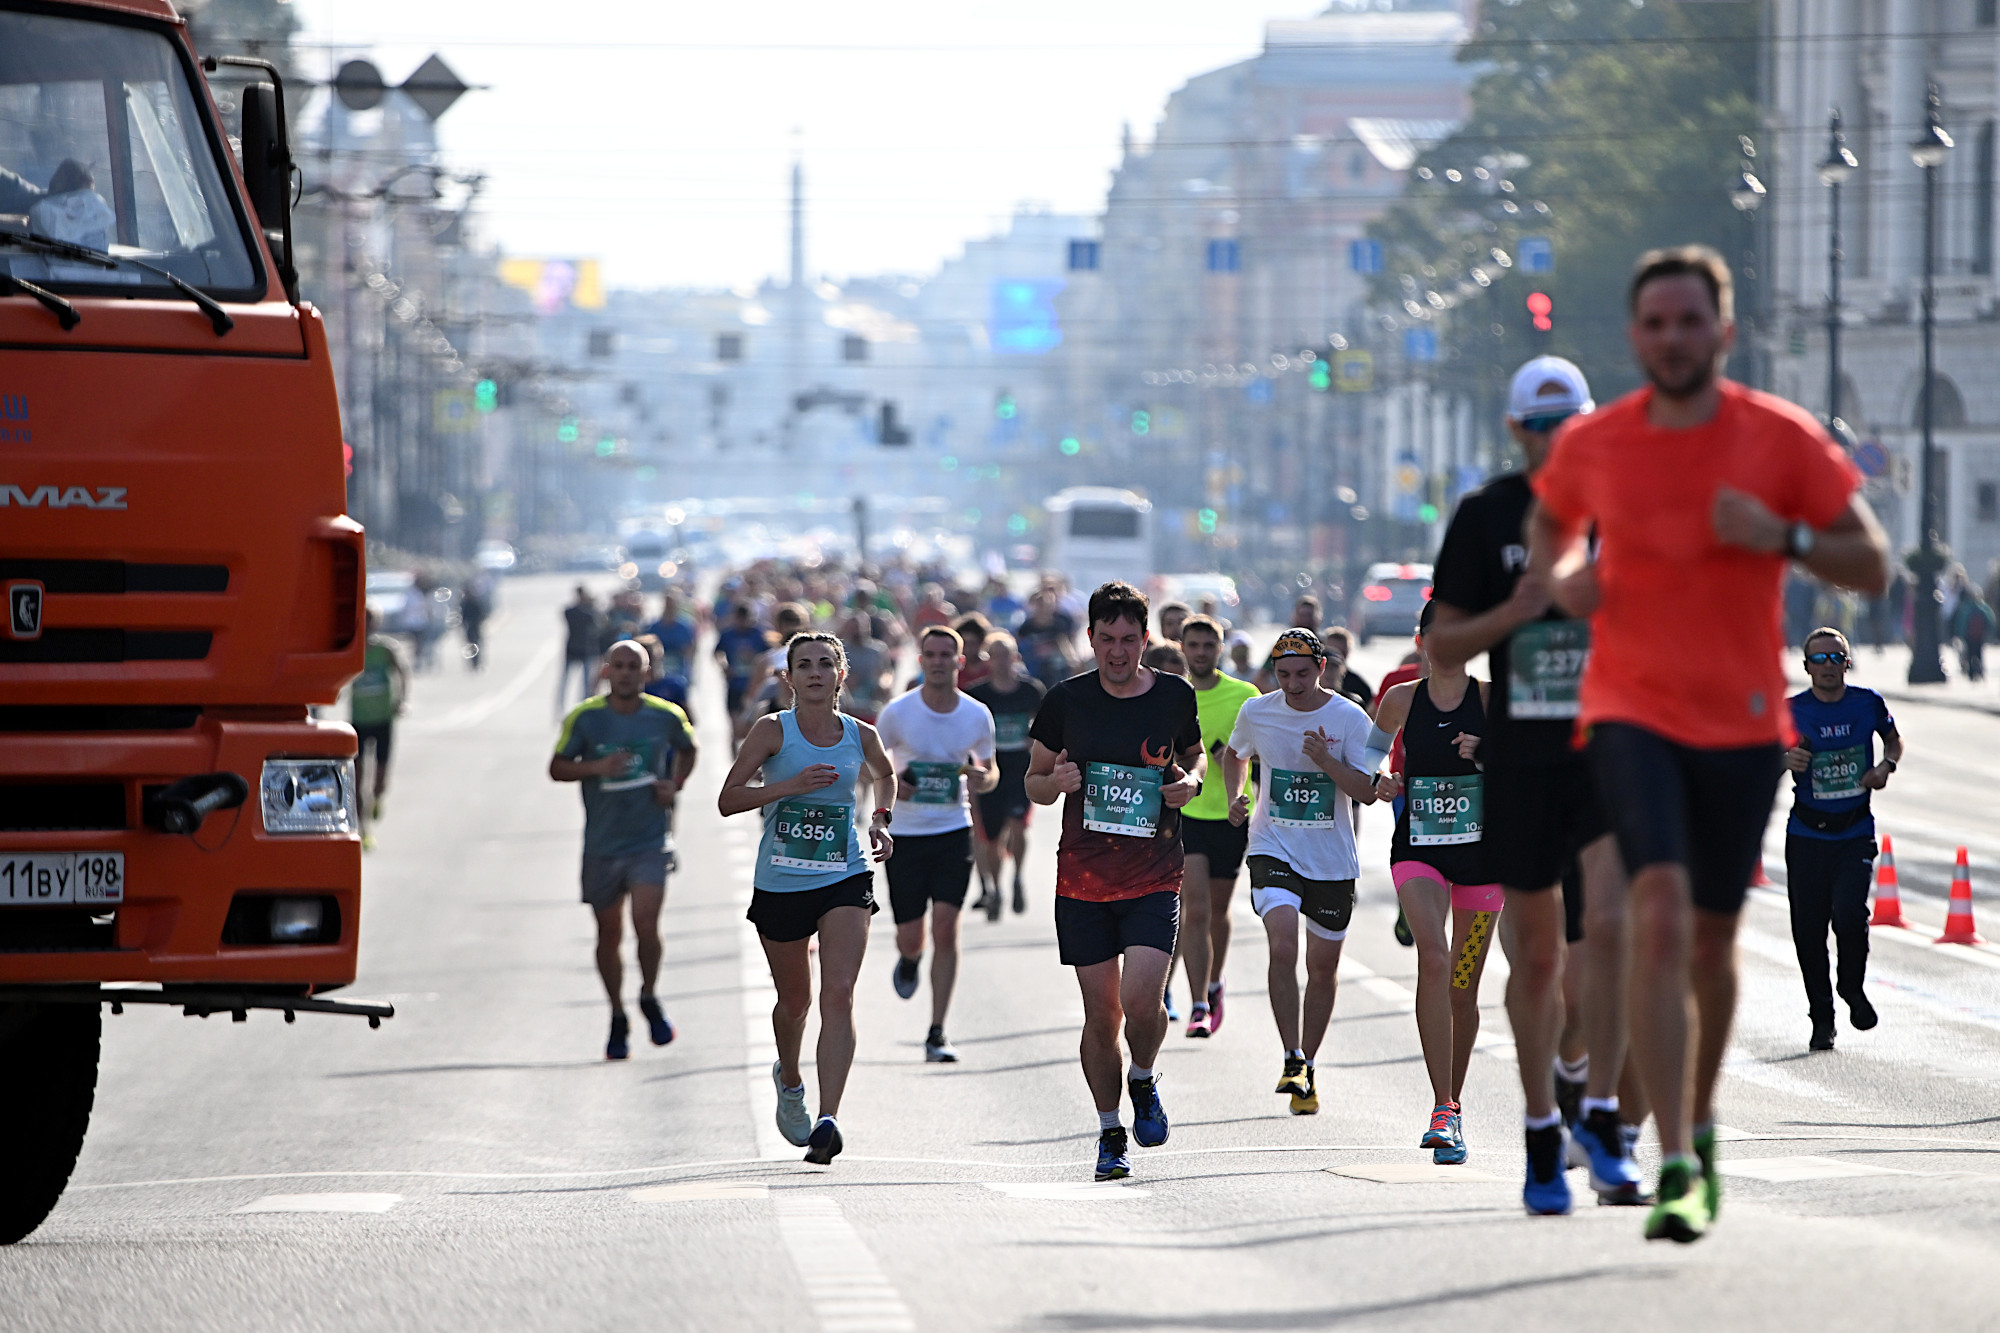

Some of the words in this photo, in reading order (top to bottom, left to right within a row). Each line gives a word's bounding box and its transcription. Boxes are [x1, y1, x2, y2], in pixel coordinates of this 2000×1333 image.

[1822, 762, 1858, 778] 2280
[918, 777, 951, 790] 2750
[1102, 784, 1143, 805] 1946
[1283, 787, 1320, 804] 6132
[1106, 804, 1135, 814] АНДРЕЙ
[1425, 796, 1470, 814] 1820
[1438, 816, 1458, 824] АННА
[790, 822, 835, 841] 6356
[78, 856, 117, 886] 198
[85, 886, 105, 898] RUS
